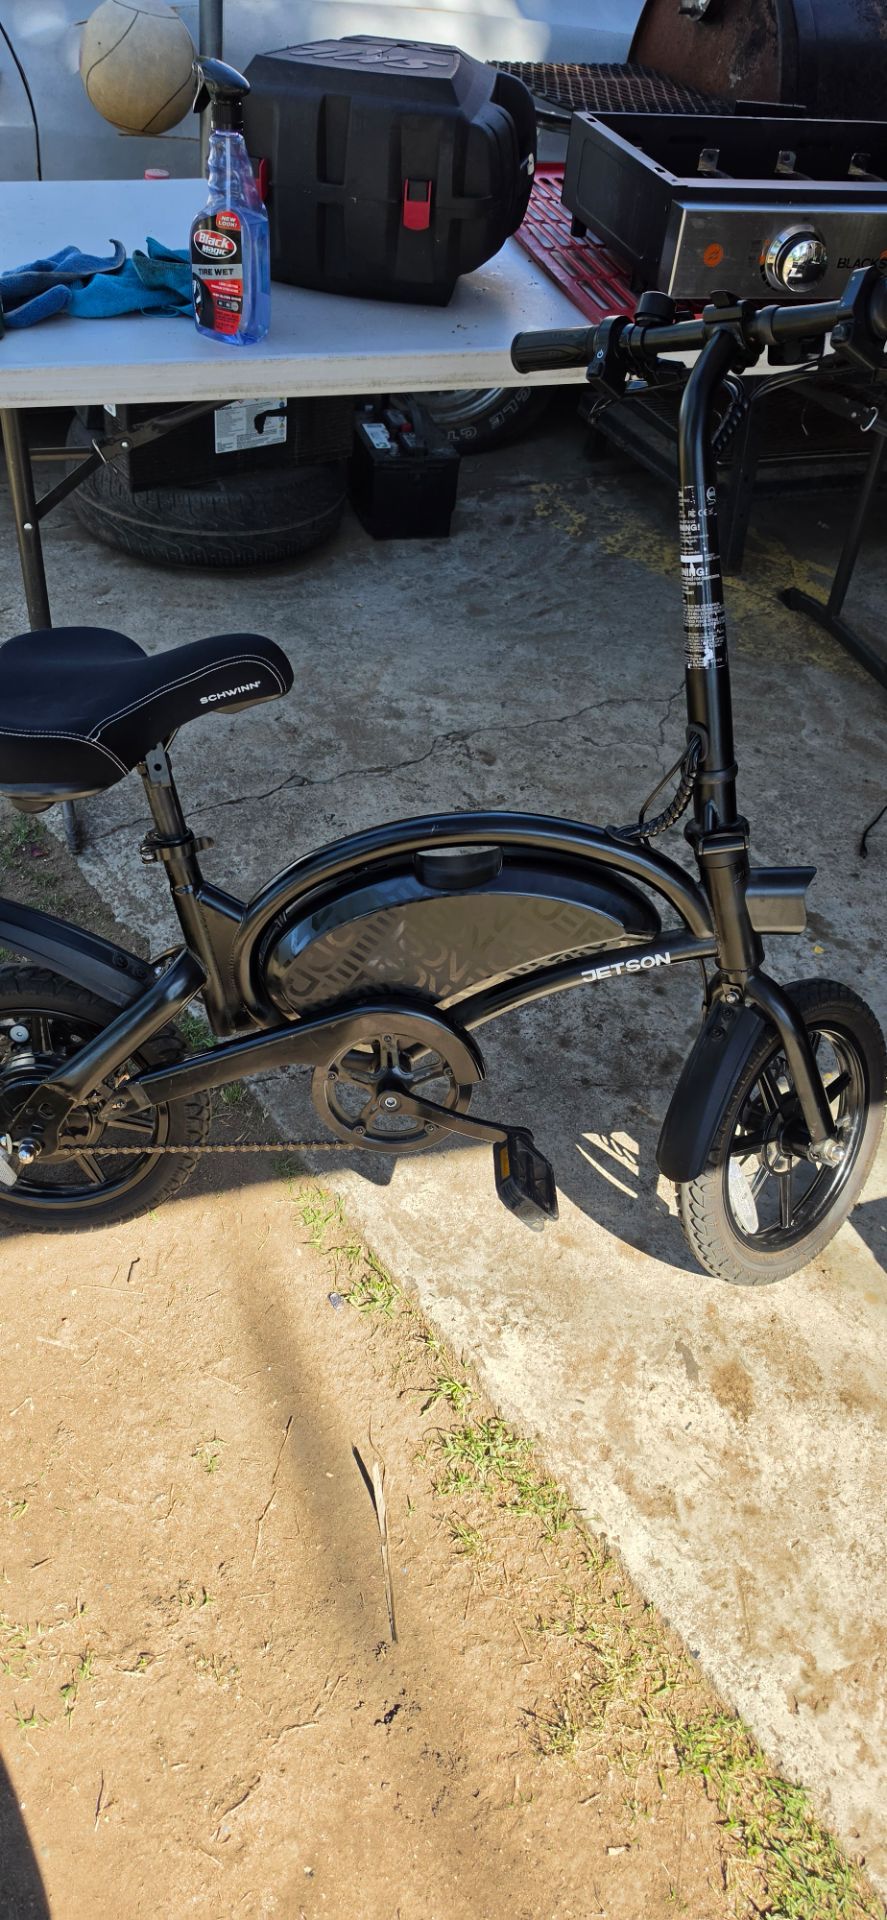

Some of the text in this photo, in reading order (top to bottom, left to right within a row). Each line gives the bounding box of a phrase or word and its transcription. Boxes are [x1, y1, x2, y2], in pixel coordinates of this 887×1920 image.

[199, 232, 230, 249] Black
[202, 244, 228, 256] Magic
[198, 268, 234, 276] TIRE WET
[199, 681, 260, 705] SCHWINN
[581, 951, 671, 982] JETSON
